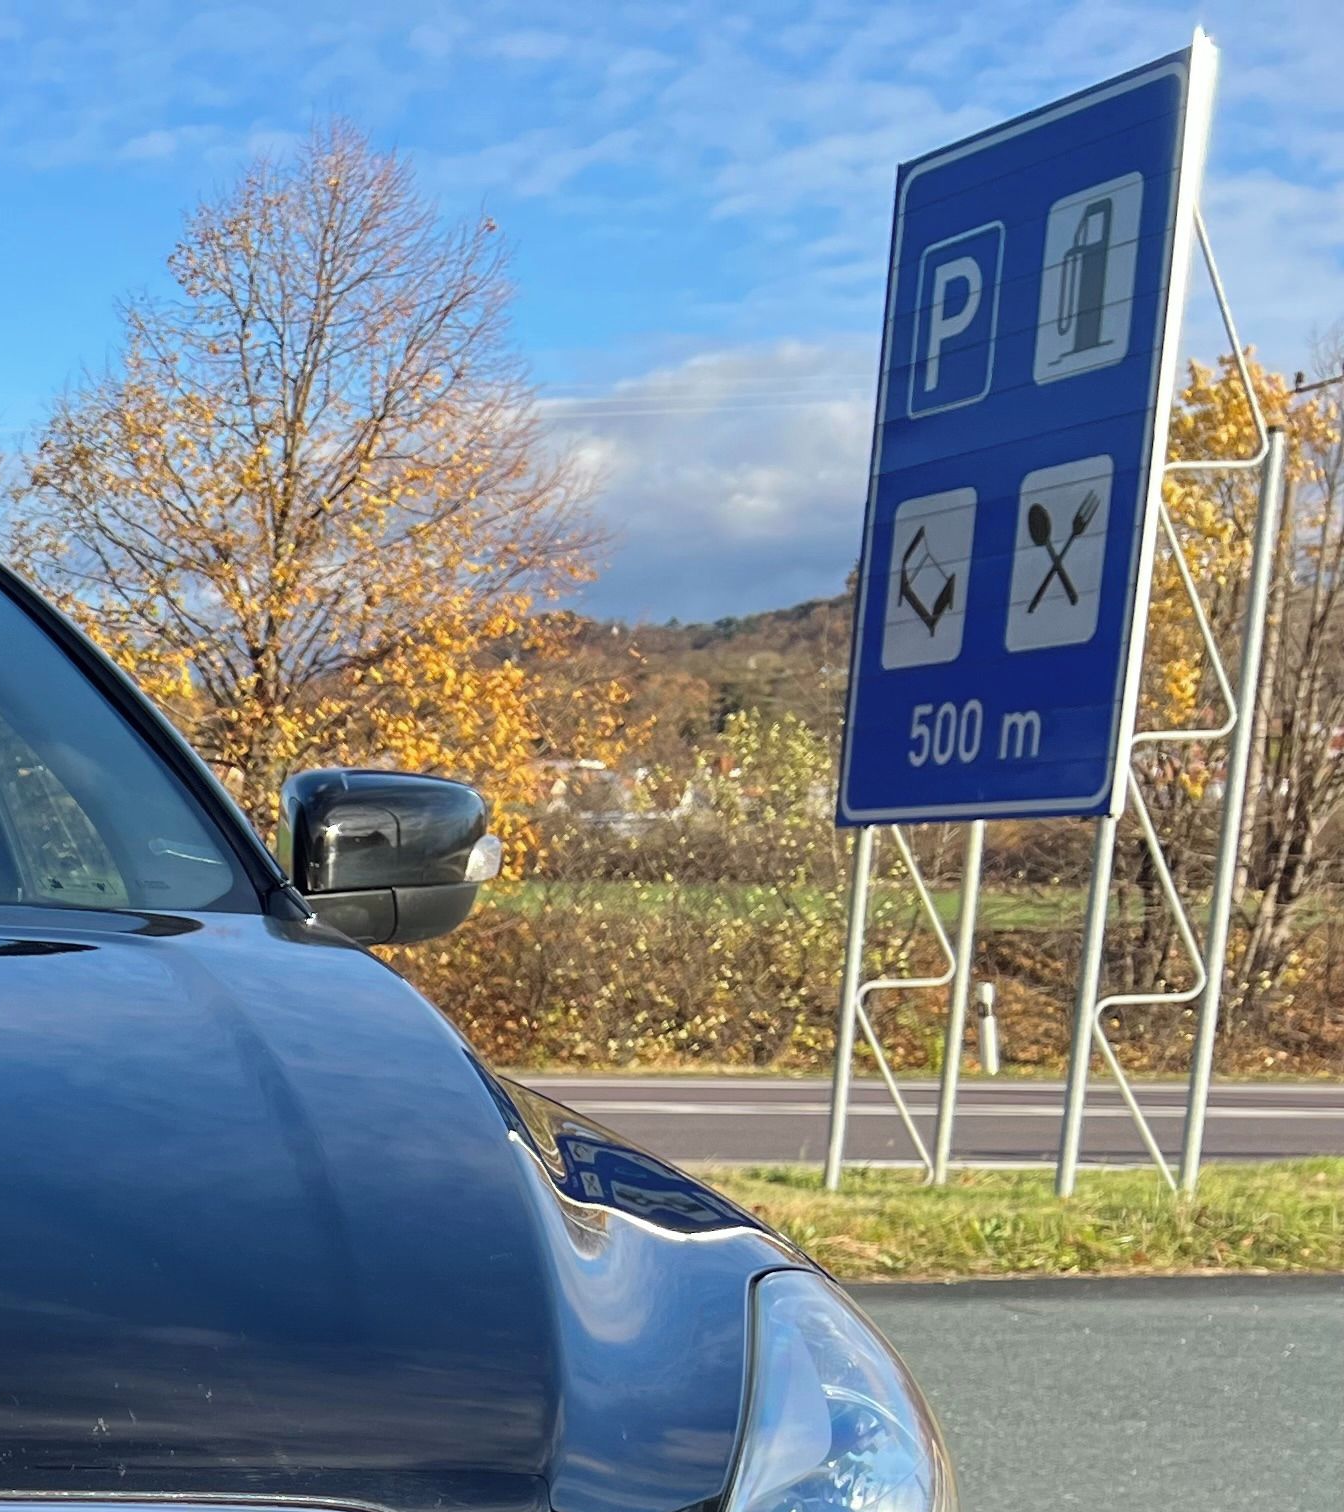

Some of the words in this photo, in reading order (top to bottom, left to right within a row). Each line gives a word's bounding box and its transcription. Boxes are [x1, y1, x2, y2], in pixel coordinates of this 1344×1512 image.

[924, 256, 982, 392] P
[909, 698, 982, 767] 500
[999, 710, 1041, 760] m
